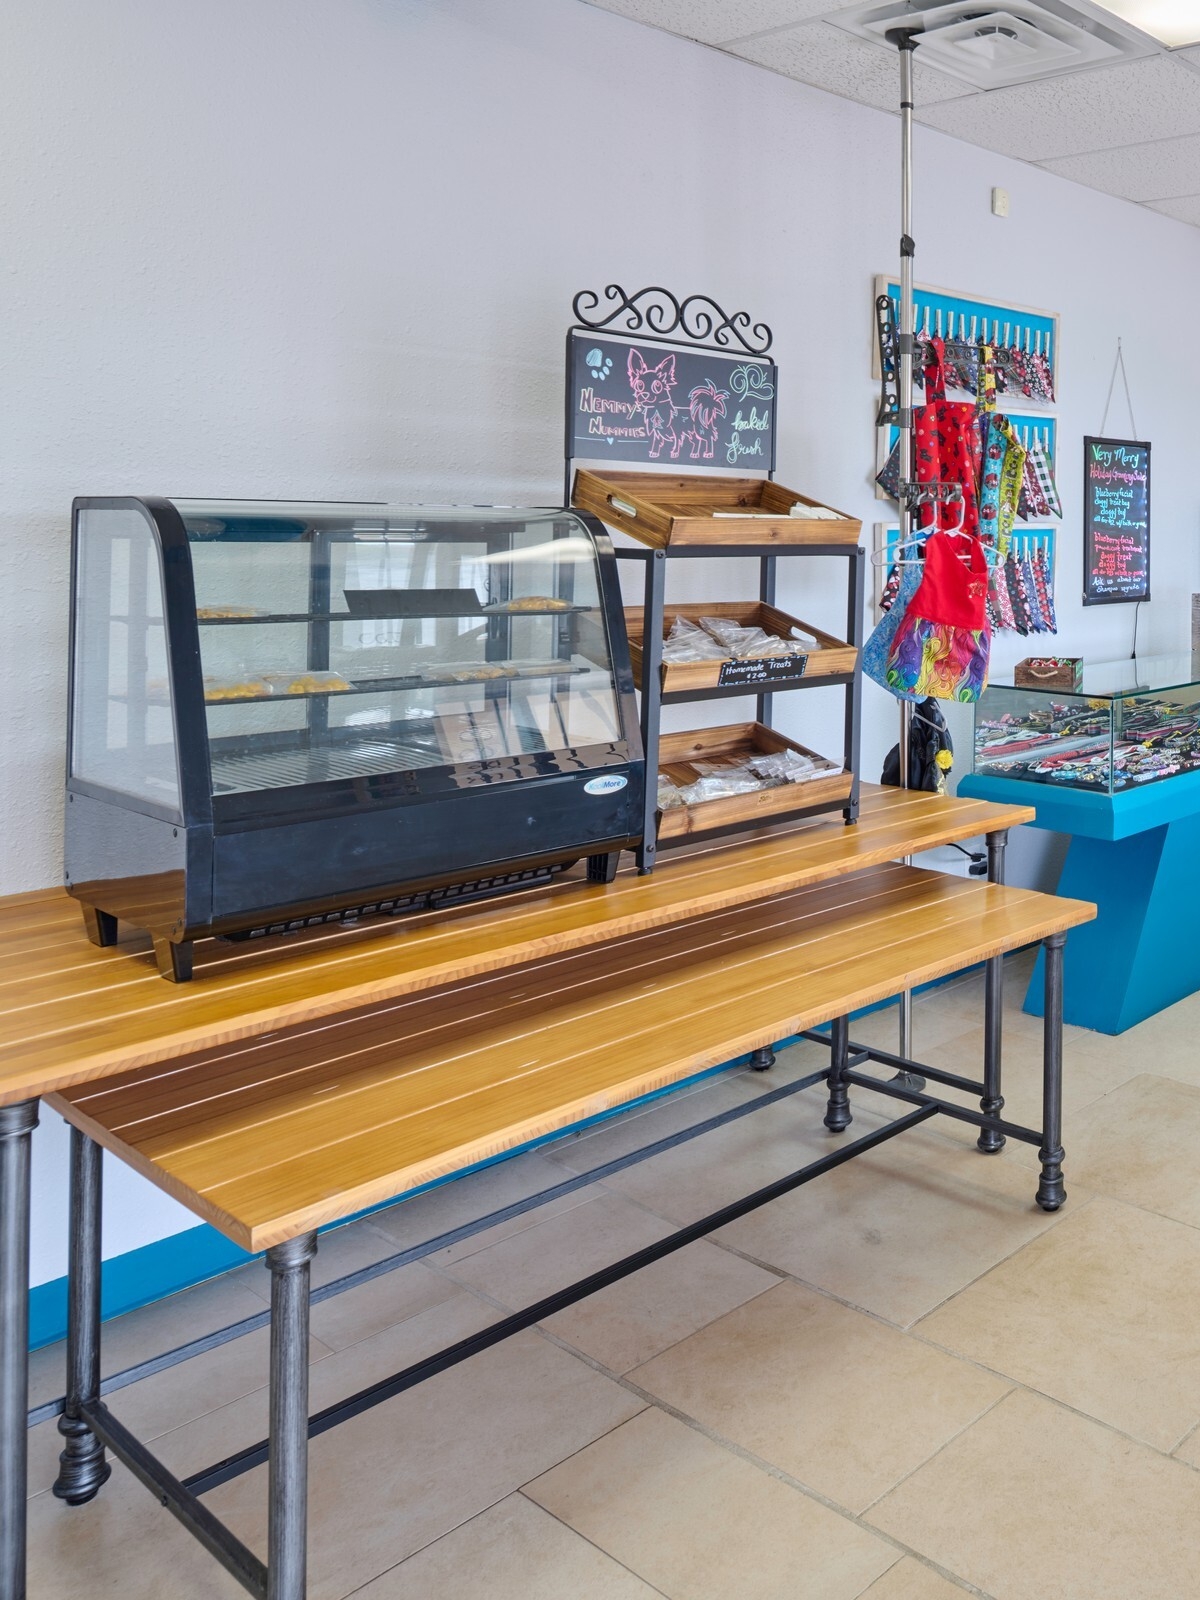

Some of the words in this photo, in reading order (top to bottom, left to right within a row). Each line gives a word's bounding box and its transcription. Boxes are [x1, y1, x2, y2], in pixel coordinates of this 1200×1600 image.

[731, 406, 769, 431] baked
[725, 432, 764, 464] fresh
[1092, 445, 1112, 466] Very
[1114, 447, 1139, 468] Merry
[1090, 462, 1111, 484] Holiday
[725, 663, 764, 675] Homemade
[768, 660, 792, 669] Treats
